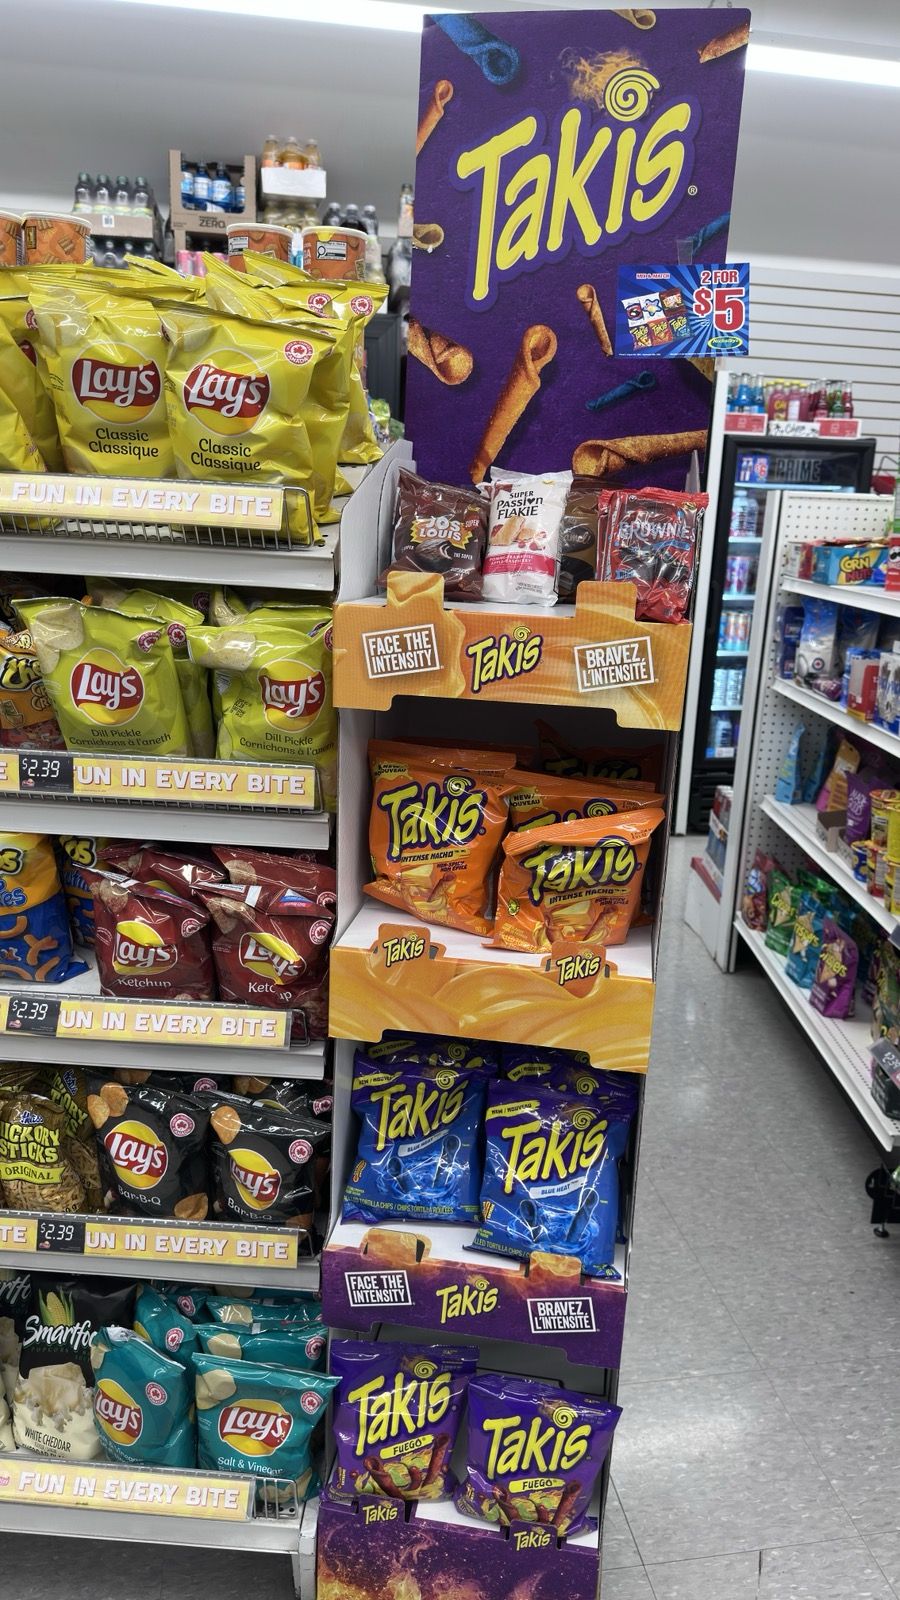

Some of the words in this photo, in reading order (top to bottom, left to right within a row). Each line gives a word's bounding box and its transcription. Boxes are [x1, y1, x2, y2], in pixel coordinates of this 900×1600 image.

[457, 67, 691, 300] Takis
[200, 220, 226, 228] ZERO
[701, 271, 711, 284] 2
[713, 270, 739, 284] FOR
[693, 286, 746, 333] $5
[80, 360, 156, 407] Lay's
[185, 364, 265, 418] Lay's
[95, 428, 149, 442] Classic
[89, 441, 159, 460] Classique
[199, 438, 252, 457] Classic
[190, 451, 262, 473] Classique
[12, 482, 66, 504] FUN
[76, 485, 102, 506] IN
[112, 488, 200, 513] EVERY
[210, 495, 273, 517] BITE
[510, 491, 534, 499] SUPER
[498, 505, 538, 519] FLAKIE
[420, 528, 461, 541] LOUIS
[425, 516, 461, 532] JOS
[840, 555, 870, 572] CORN
[369, 634, 402, 656] FACE
[405, 631, 431, 651] THE
[372, 649, 433, 673] INTENSITY
[467, 625, 542, 692] Takis
[586, 644, 641, 665] BRAVEZ
[583, 657, 649, 687] L'INTENSITÉ
[77, 664, 137, 710] Lay's
[265, 676, 321, 717] Lay's
[69, 736, 127, 747] Cornichons
[136, 733, 172, 747] l'aneth
[91, 728, 110, 738] Dill
[112, 729, 141, 738] Pickle
[265, 732, 282, 742] Dill
[284, 736, 313, 746] Pickle
[240, 737, 295, 754] Cornichons
[22, 758, 60, 778] $2.39
[74, 765, 111, 786] UN
[121, 767, 145, 787] IN
[156, 769, 237, 791] EVERY
[247, 774, 305, 794] BITE
[511, 799, 540, 807] OUVEAU
[381, 777, 484, 858] Takis
[401, 853, 430, 863] INTENSE
[431, 850, 454, 859] NACHO
[549, 892, 584, 905] INTENSE
[585, 888, 614, 897] NACHO
[243, 937, 299, 977] Lays
[384, 932, 424, 966] Takis
[557, 951, 601, 985] Takis
[117, 977, 172, 989] Ketchup
[248, 982, 293, 1001] Ketcup
[12, 1000, 48, 1020] $2.39
[60, 1008, 93, 1029] UN
[102, 1012, 126, 1031] IN
[135, 1013, 211, 1035] EVERY
[221, 1017, 277, 1037] BITE
[370, 1070, 469, 1151] Takis
[0, 1139, 59, 1164] STICKS
[109, 1133, 164, 1176] Lay's
[502, 1110, 608, 1193] Takis
[5, 1166, 54, 1181] ORIGINAL
[541, 1187, 556, 1195] BLUE
[556, 1183, 570, 1194] HEAT
[0, 1226, 27, 1243] TE
[41, 1222, 74, 1241] $2.39
[86, 1231, 116, 1249] UN
[125, 1232, 147, 1252] IN
[155, 1235, 228, 1257] EVERY
[236, 1239, 289, 1260] BITE
[473, 1239, 487, 1249] LLED
[487, 1241, 508, 1252] TORTILLA
[350, 1275, 379, 1290] FACE
[381, 1274, 404, 1288] THE
[352, 1288, 405, 1303] INTENSITY
[436, 1278, 498, 1323] Takis
[537, 1301, 585, 1316] BRAVEZ
[534, 1311, 592, 1330] L'INTENSITÉ
[23, 1315, 98, 1350] Smartfo
[96, 1392, 140, 1431] Lay's
[348, 1361, 452, 1456] Takis
[226, 1405, 290, 1442] Lay's
[25, 1426, 43, 1443] WHITE
[43, 1434, 72, 1452] CHEDDAR
[392, 1439, 422, 1456] FUEGO
[483, 1406, 592, 1479] Takis
[218, 1456, 236, 1467] Salt
[237, 1459, 245, 1469] &
[247, 1461, 283, 1476] Vinegar
[18, 1472, 66, 1494] FUN
[73, 1476, 97, 1498] IN
[103, 1479, 178, 1504] EVERY
[186, 1486, 240, 1509] BITE
[522, 1479, 553, 1489] FUEGO
[363, 1501, 398, 1525] Takis
[513, 1527, 551, 1551] Takis
